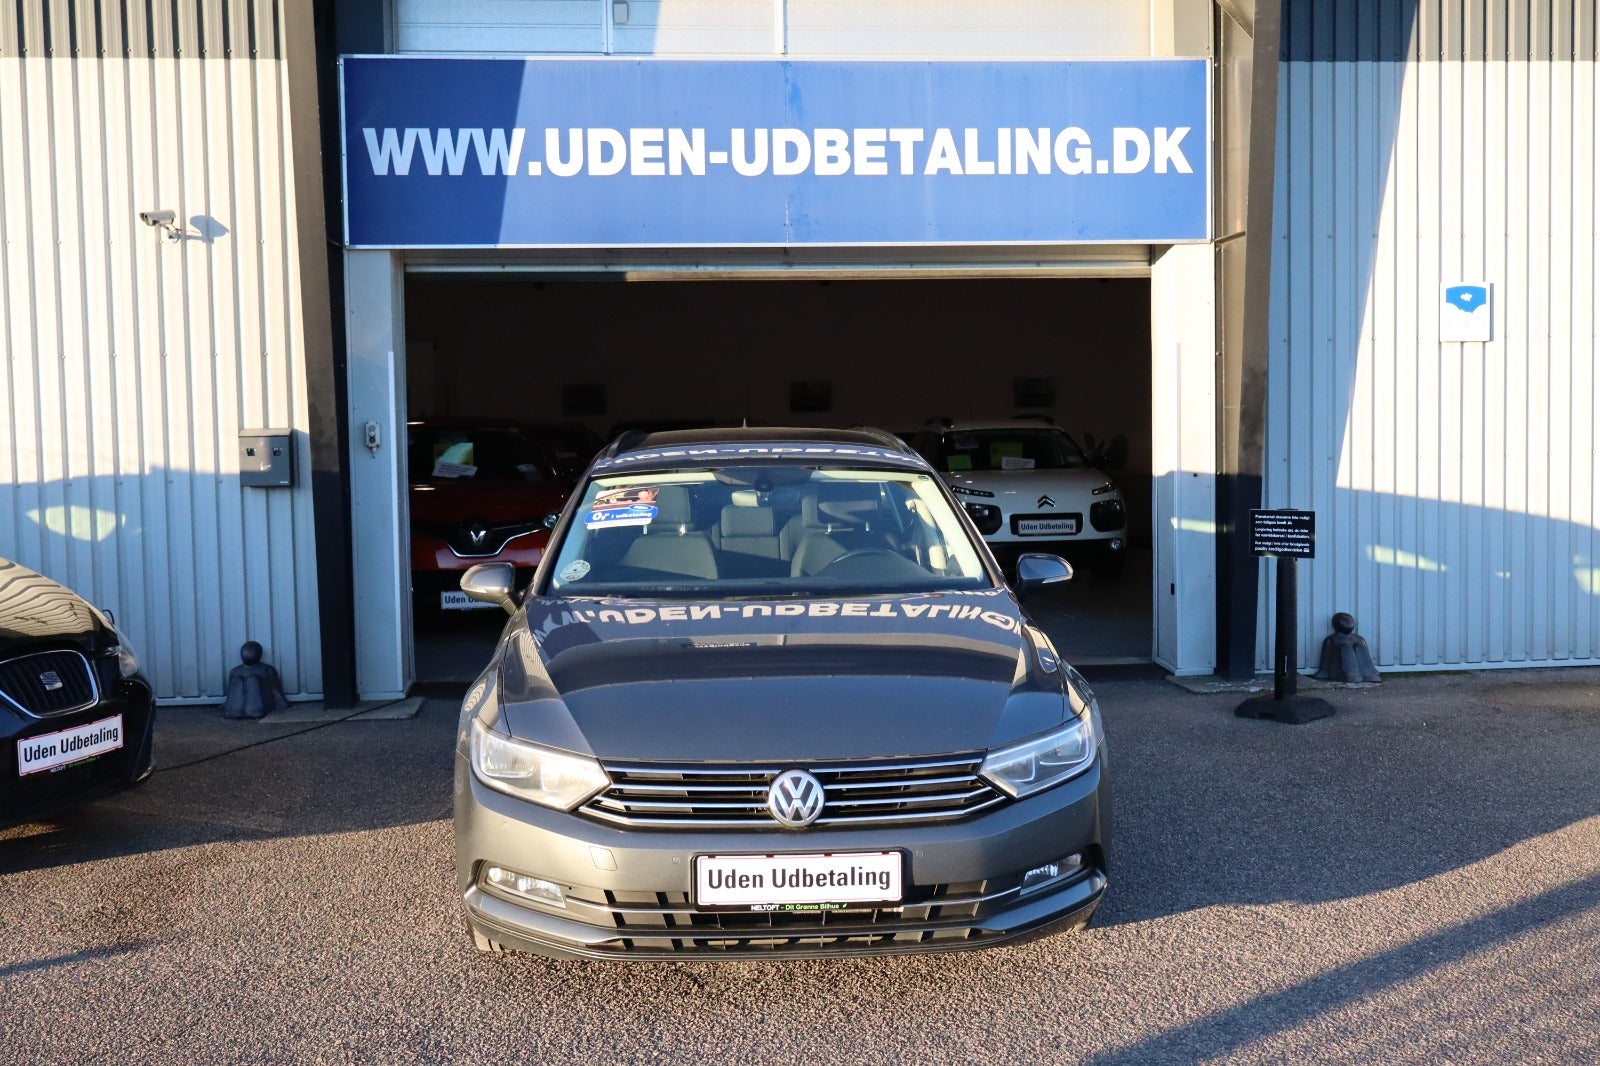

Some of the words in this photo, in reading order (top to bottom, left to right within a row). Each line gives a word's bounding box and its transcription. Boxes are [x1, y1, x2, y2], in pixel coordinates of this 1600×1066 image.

[363, 127, 1193, 176] WWW.UDEN-UDBETALING.DK
[1039, 522, 1074, 531] Udbetaling
[444, 595, 466, 604] Uden
[24, 744, 57, 763] Uden
[60, 727, 119, 754] Udbetaling
[708, 868, 764, 889] Uden
[772, 866, 891, 890] Udbetaling
